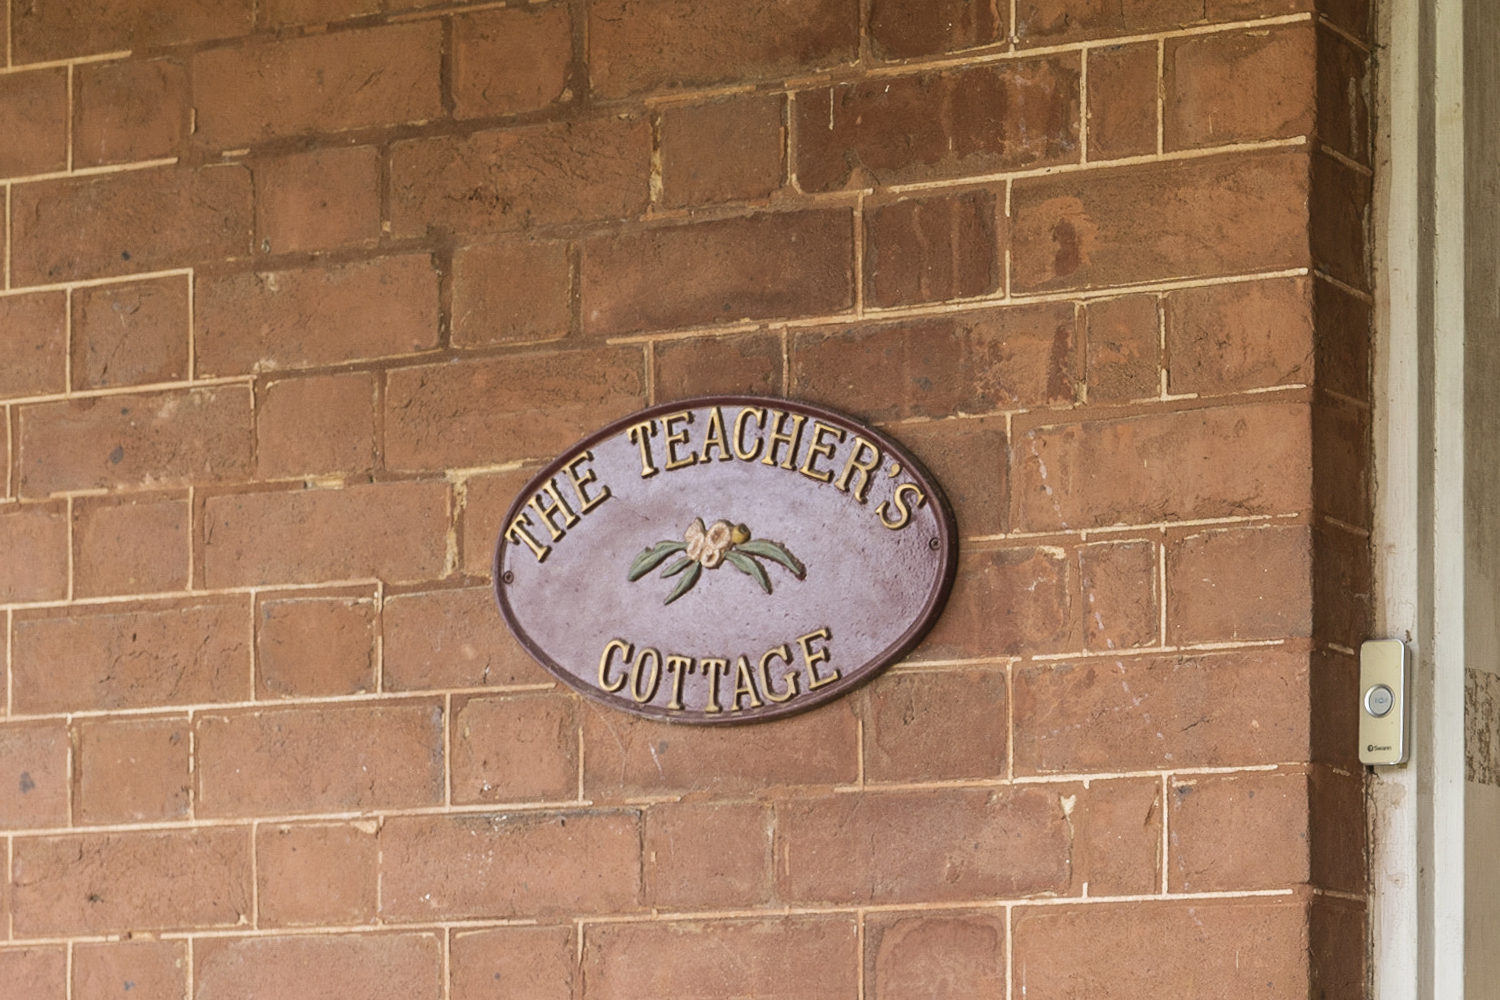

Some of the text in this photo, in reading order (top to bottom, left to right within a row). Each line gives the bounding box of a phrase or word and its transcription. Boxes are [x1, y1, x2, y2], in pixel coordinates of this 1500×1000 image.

[504, 406, 926, 562] THE TEACHER'S
[598, 627, 842, 713] COTTAGE
